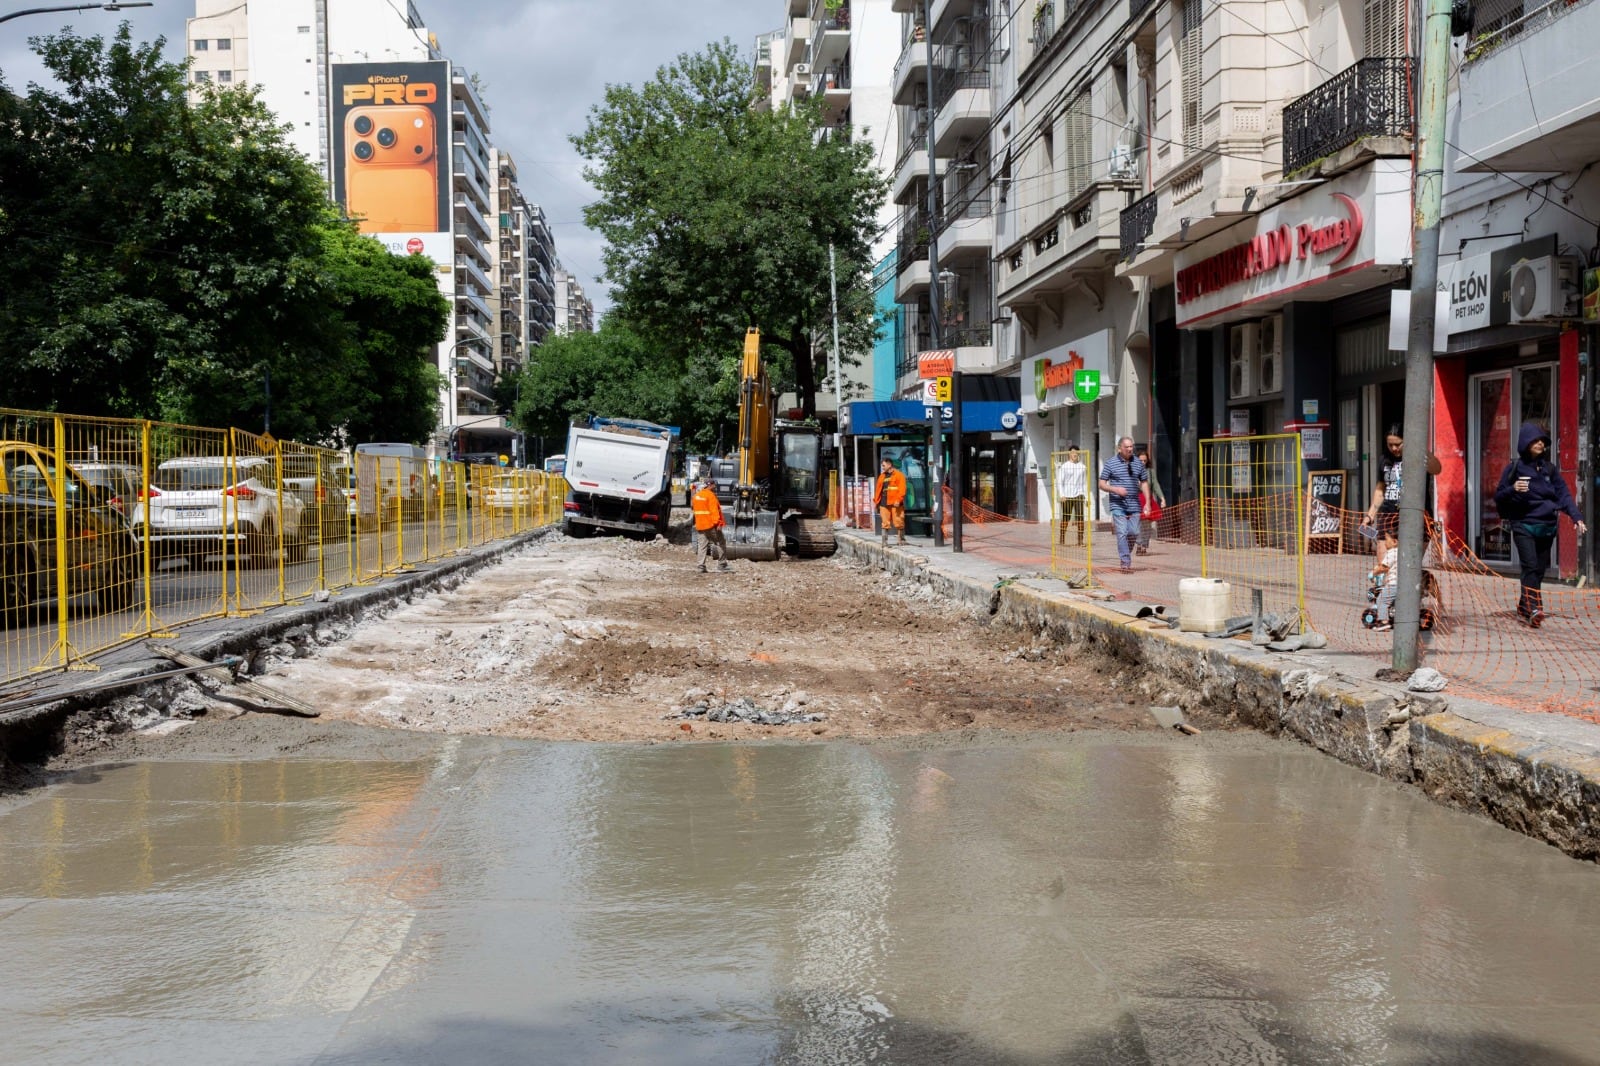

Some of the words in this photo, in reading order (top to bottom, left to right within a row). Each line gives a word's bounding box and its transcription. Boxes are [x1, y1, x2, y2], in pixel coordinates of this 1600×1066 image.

[374, 75, 400, 83] iPhone
[400, 75, 408, 83] 17
[343, 82, 437, 106] PRO
[392, 242, 403, 251] EN
[1451, 270, 1488, 305] LEÓN
[1455, 306, 1467, 319] PET
[1467, 302, 1485, 316] SHOP
[925, 407, 953, 419] RS
[1331, 476, 1342, 485] DE
